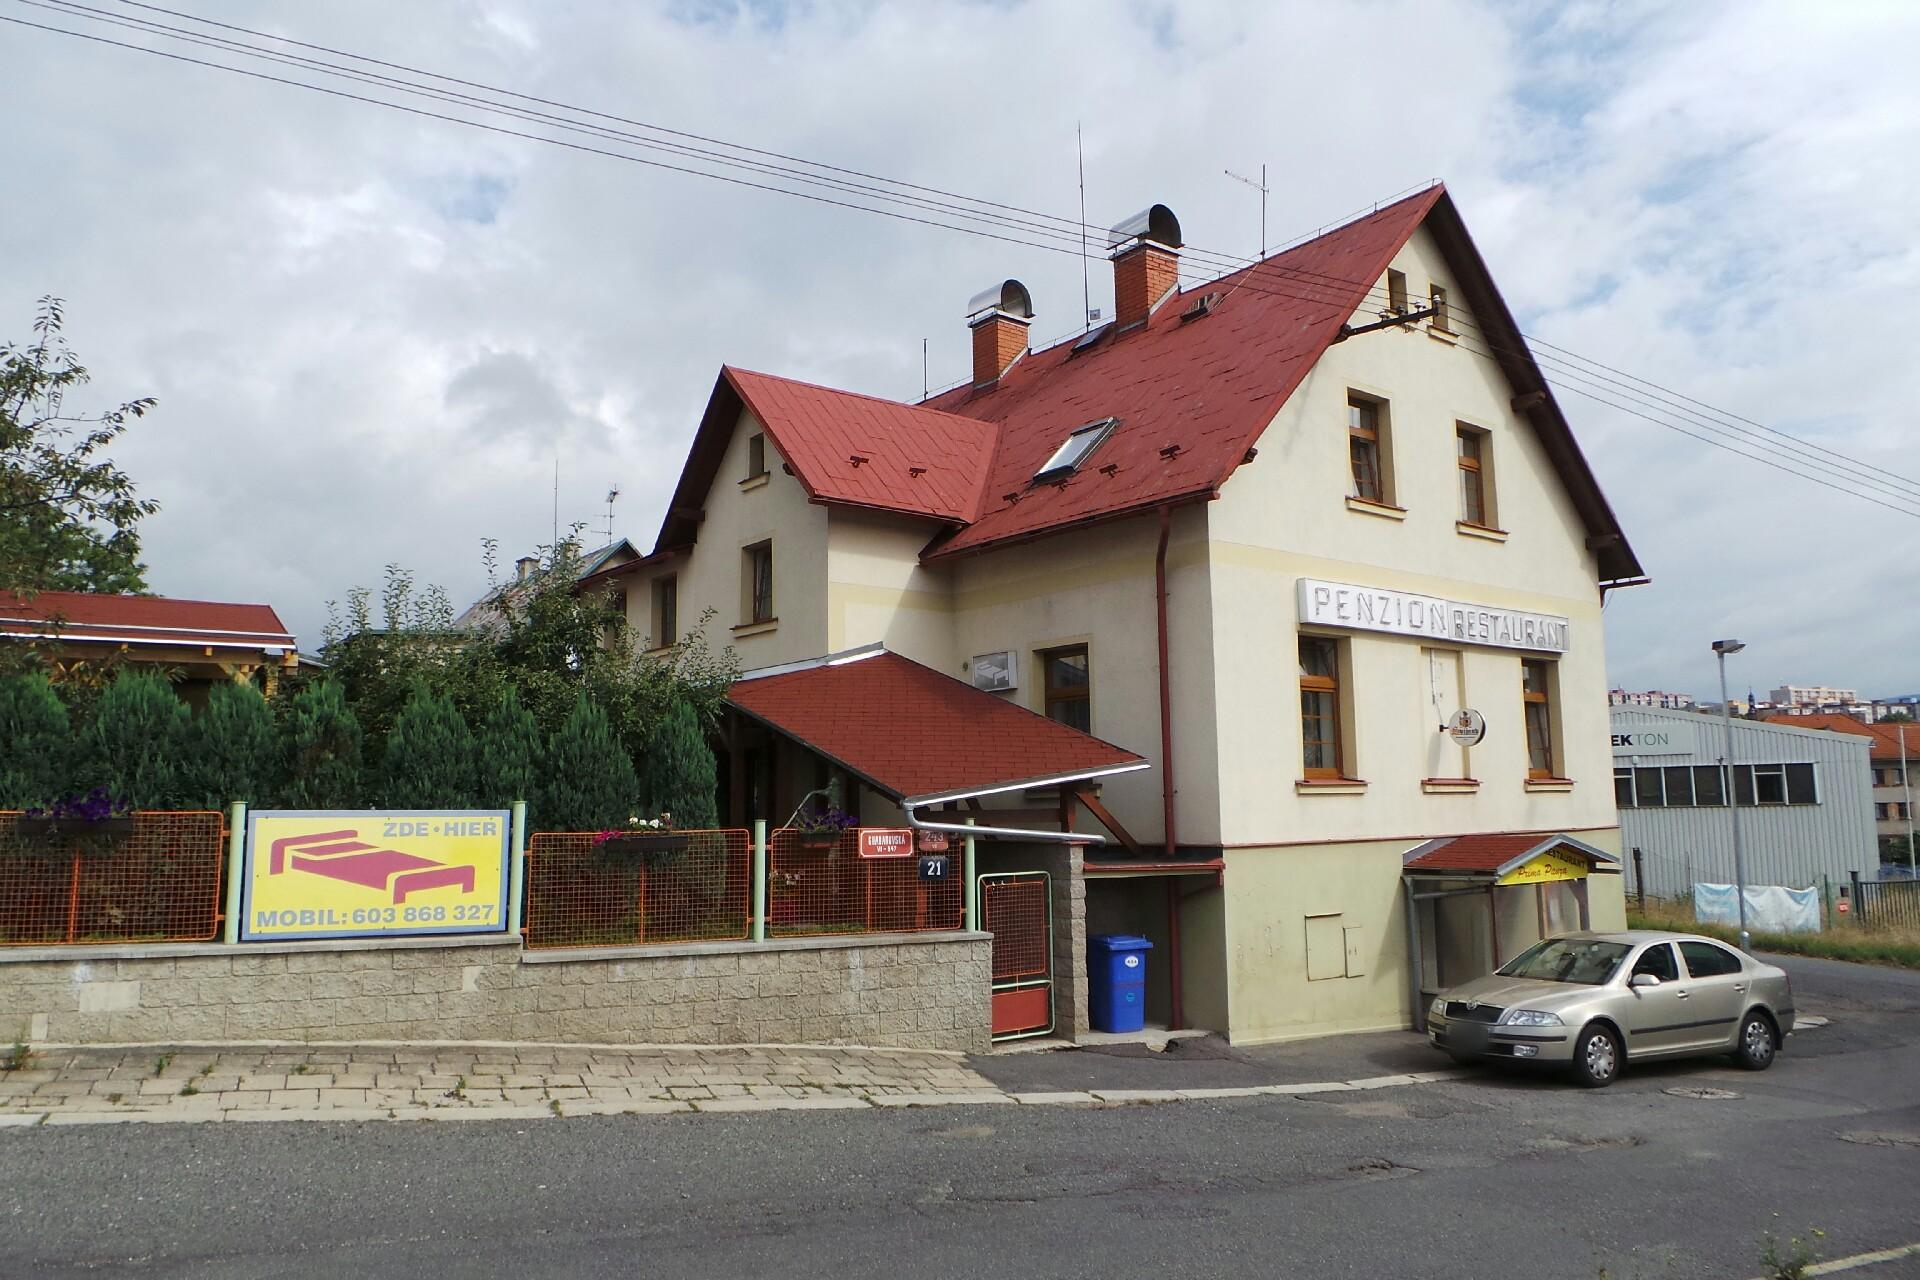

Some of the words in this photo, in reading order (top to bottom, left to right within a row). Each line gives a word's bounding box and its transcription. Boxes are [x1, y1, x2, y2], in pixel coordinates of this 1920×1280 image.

[1314, 586, 1448, 634] PENZION
[1453, 608, 1569, 650] RESTAURANT
[383, 821, 429, 838] ZDE
[444, 821, 497, 837] HIER
[927, 861, 941, 876] 21
[257, 909, 348, 928] MOBIL:
[352, 908, 396, 925] 603
[403, 906, 446, 923] 868
[452, 904, 495, 922] 327
